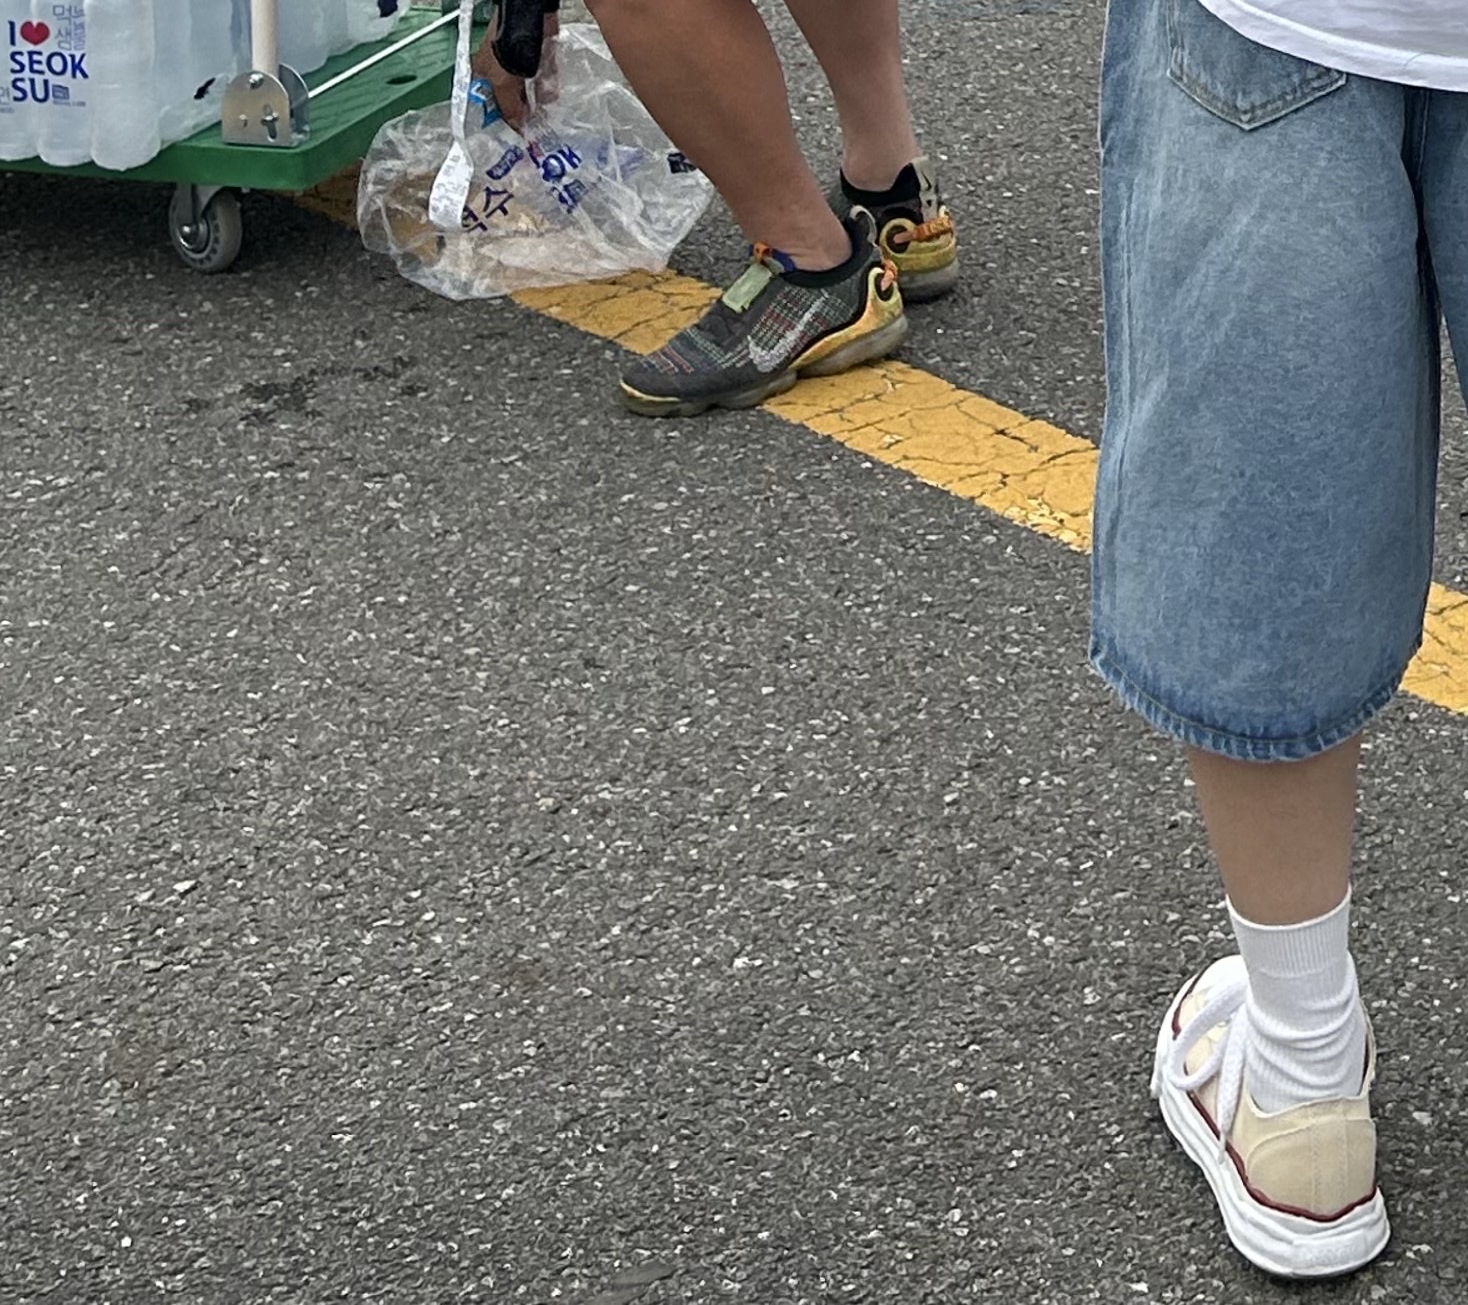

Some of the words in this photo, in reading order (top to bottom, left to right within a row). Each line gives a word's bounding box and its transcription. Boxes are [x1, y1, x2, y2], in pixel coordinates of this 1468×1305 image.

[8, 20, 16, 47] I
[10, 50, 89, 79] SEOK
[11, 77, 50, 103] SU
